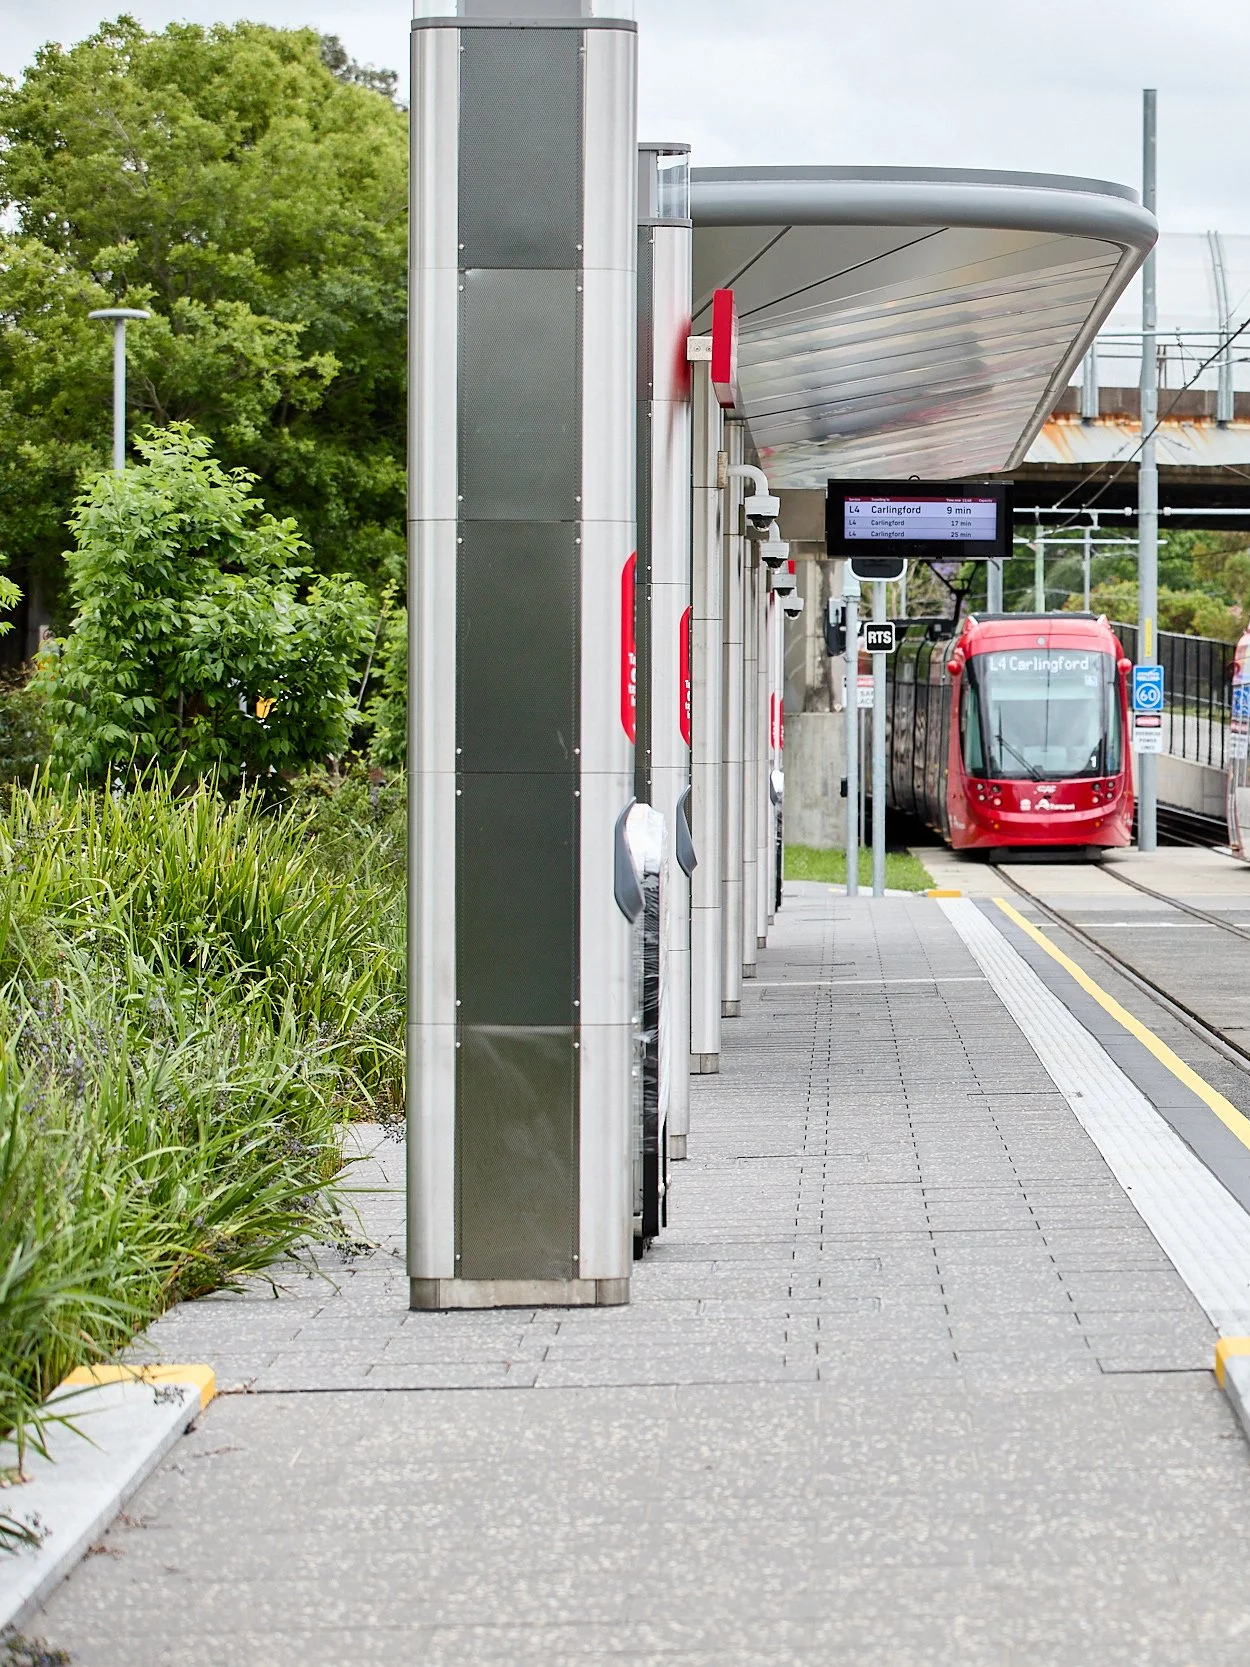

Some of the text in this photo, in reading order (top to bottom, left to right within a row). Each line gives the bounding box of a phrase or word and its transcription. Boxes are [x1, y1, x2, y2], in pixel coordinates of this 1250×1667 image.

[849, 505, 921, 515] L4 Carlingford
[946, 506, 972, 515] 9 min
[870, 519, 905, 527] Carlingford
[867, 630, 892, 644] RTS
[989, 655, 1089, 674] L4 Carlingford
[1139, 689, 1157, 702] 60
[1090, 755, 1097, 768] 1
